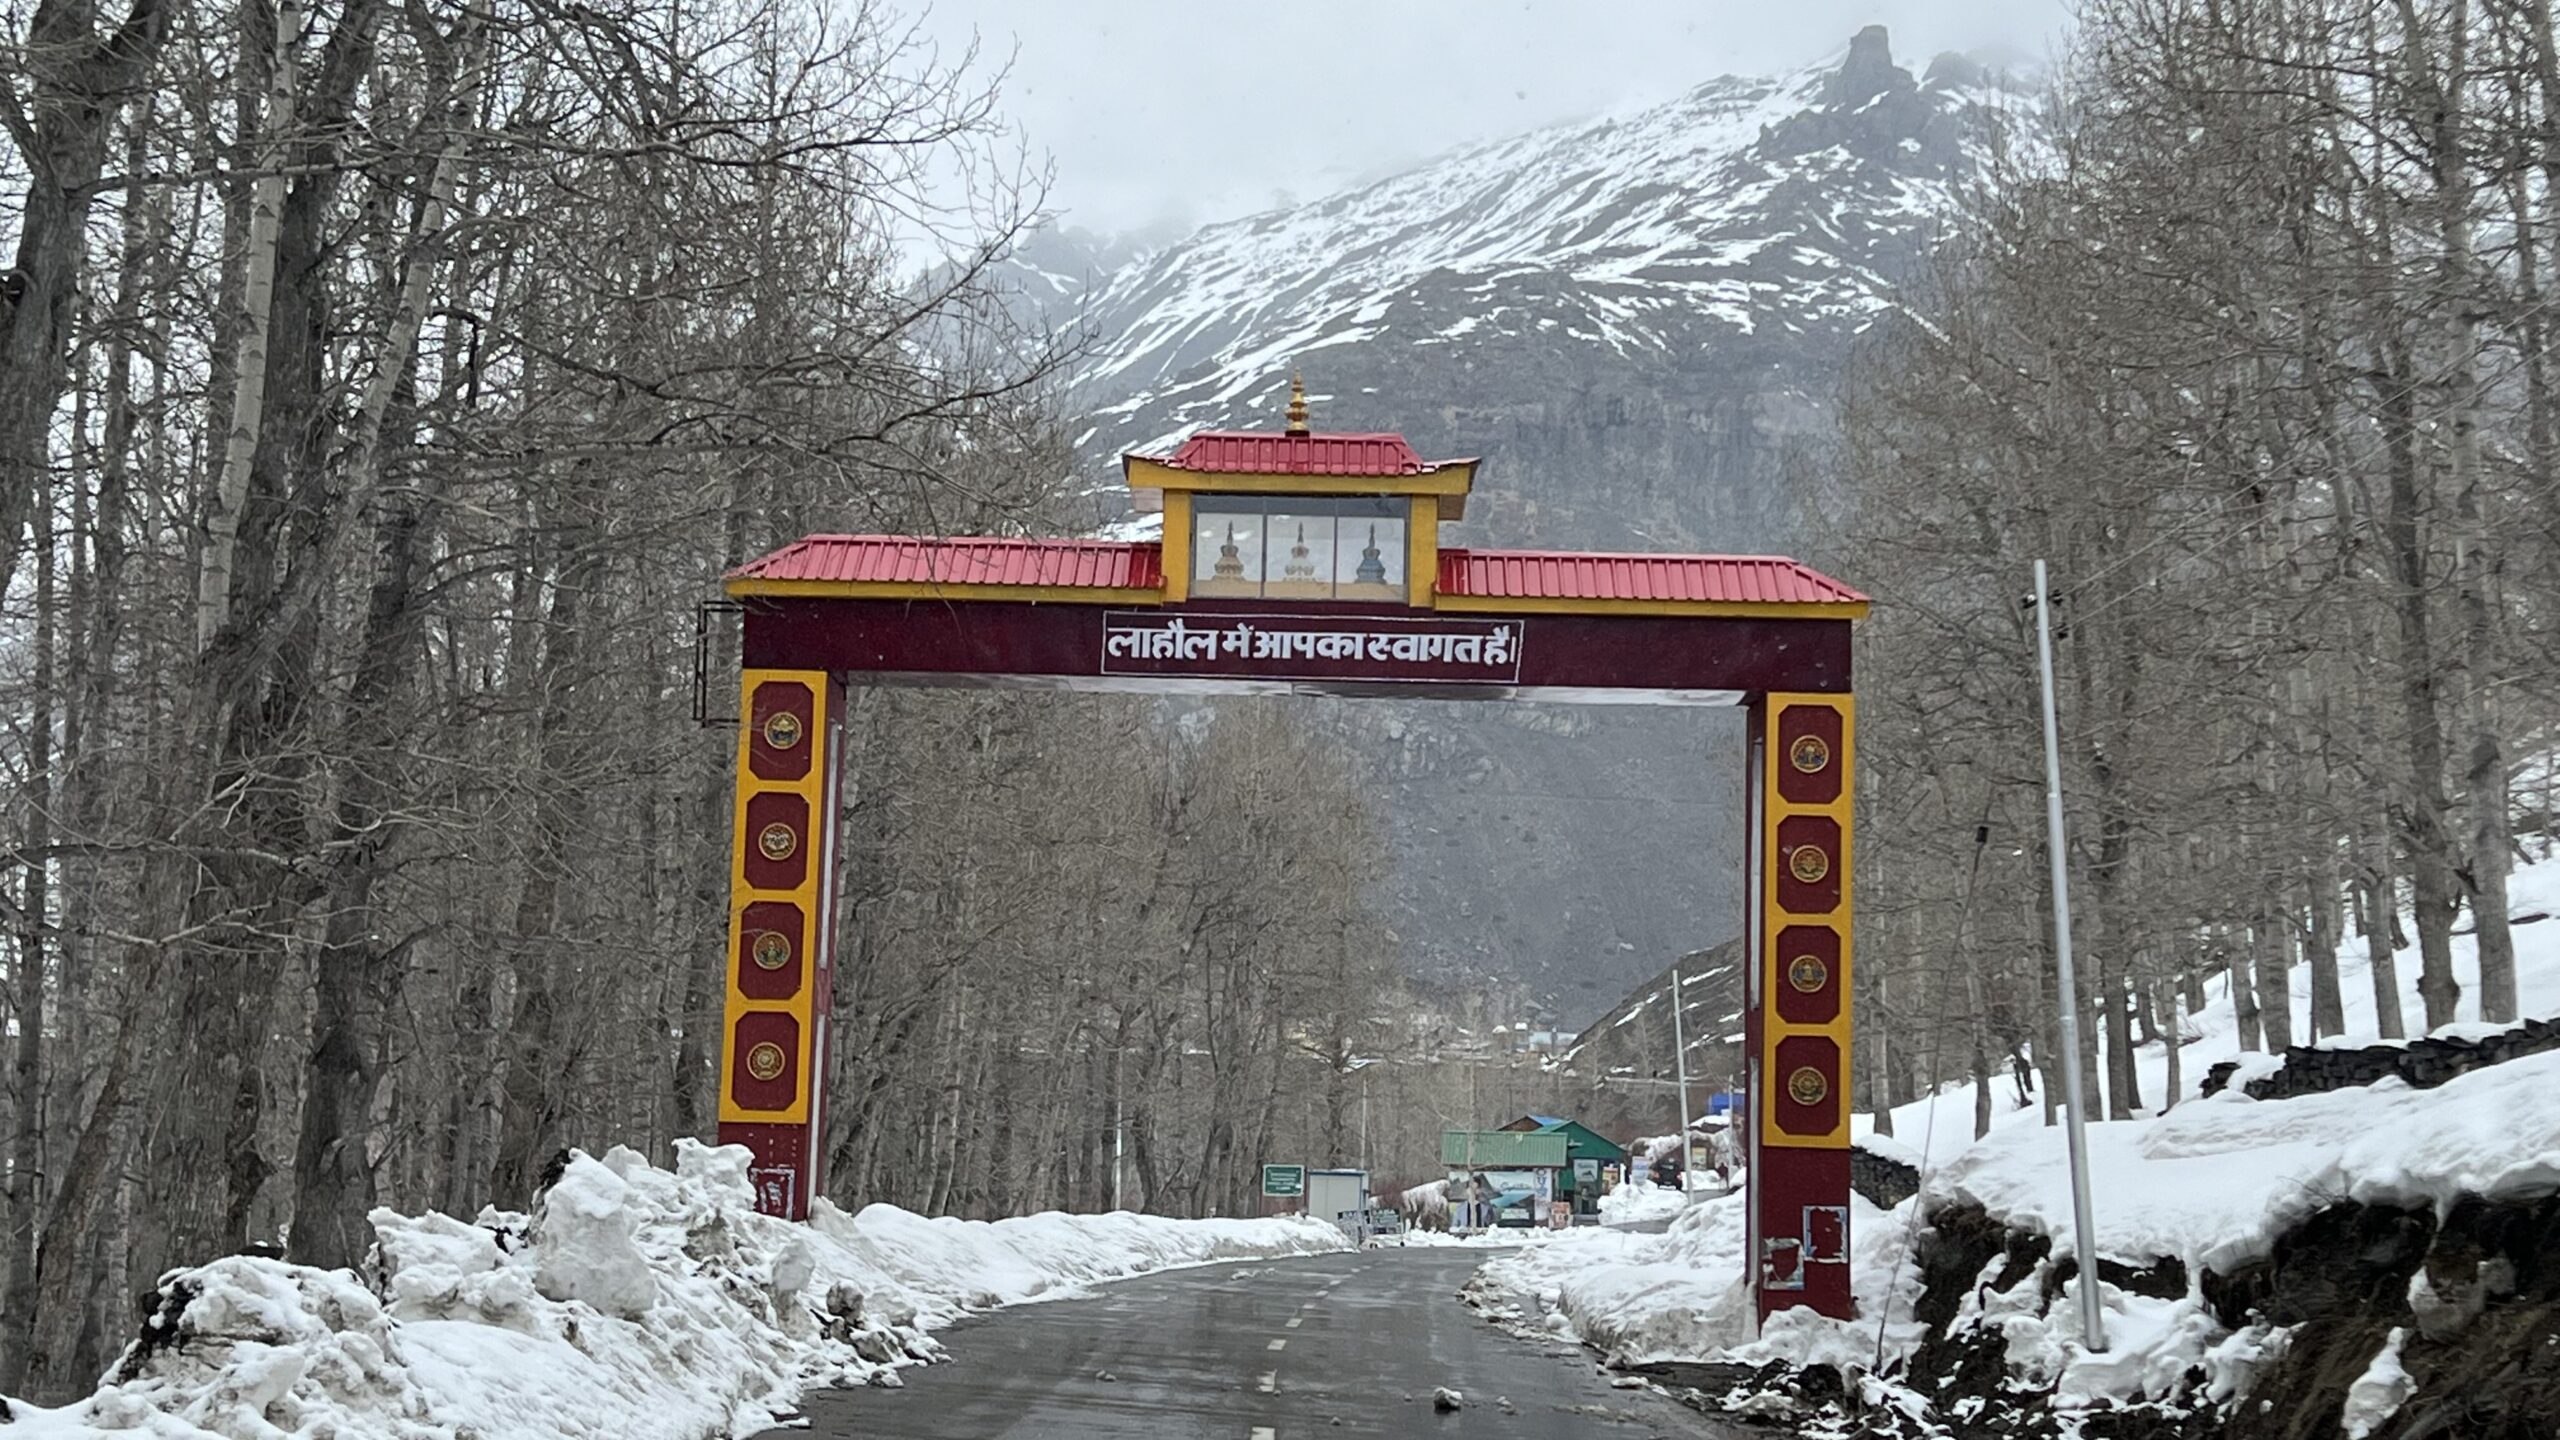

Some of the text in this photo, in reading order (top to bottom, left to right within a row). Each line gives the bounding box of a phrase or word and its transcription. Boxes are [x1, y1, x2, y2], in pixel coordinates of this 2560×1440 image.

[1107, 618, 1219, 660] लाहौल
[1222, 623, 1254, 658] में
[1253, 631, 1367, 660] आपका
[1367, 633, 1484, 663] स्वागत
